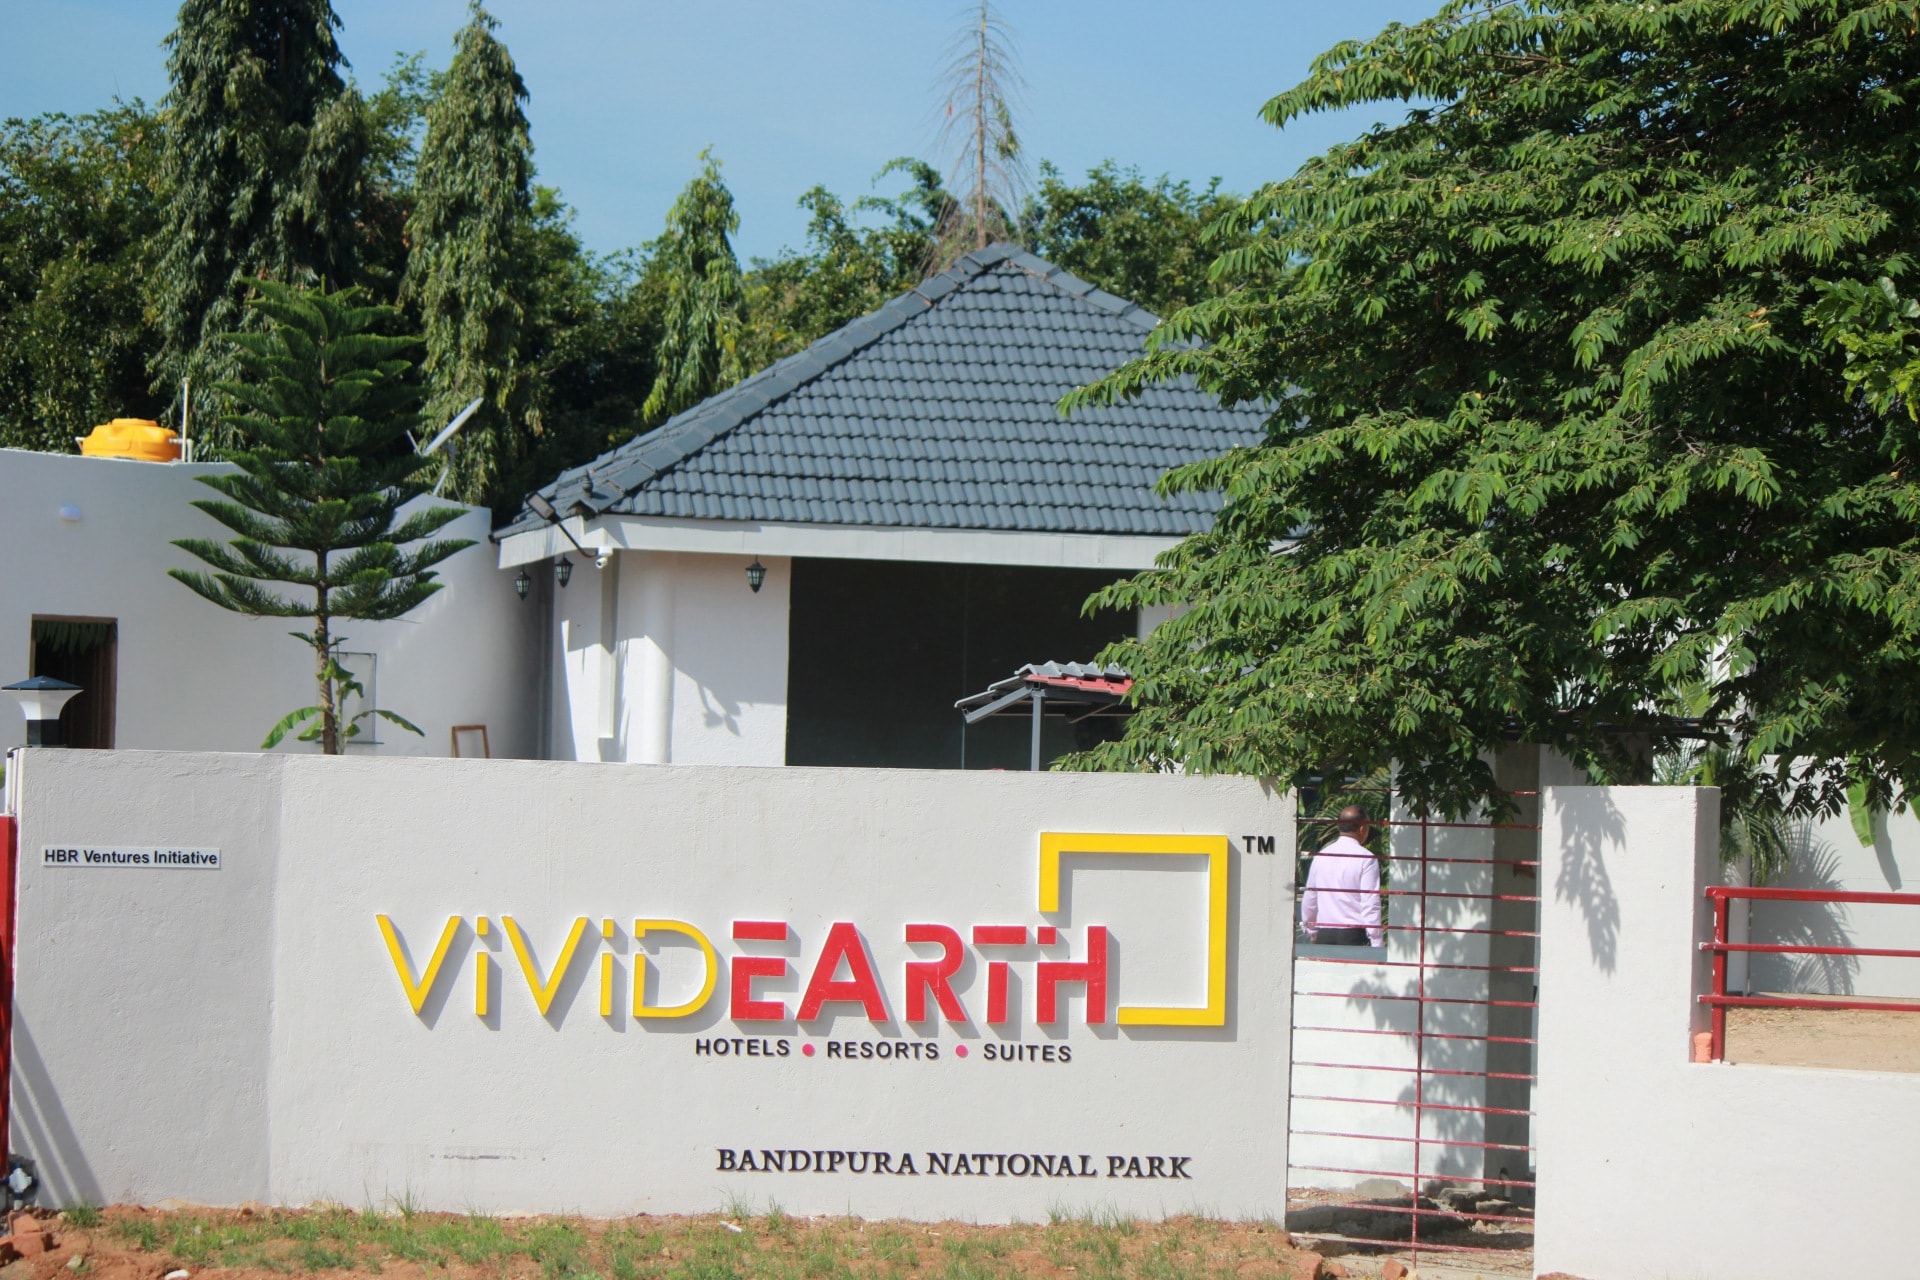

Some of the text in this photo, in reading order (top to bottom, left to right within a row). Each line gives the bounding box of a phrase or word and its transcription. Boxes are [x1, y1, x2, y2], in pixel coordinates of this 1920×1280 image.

[1242, 835, 1275, 854] TM
[44, 849, 217, 865] HBR Ventures Initiative
[695, 1038, 1072, 1063] HOTELS RESORTS SUITES
[716, 1148, 1193, 1179] BANDIPURA NATIONAL PARK
